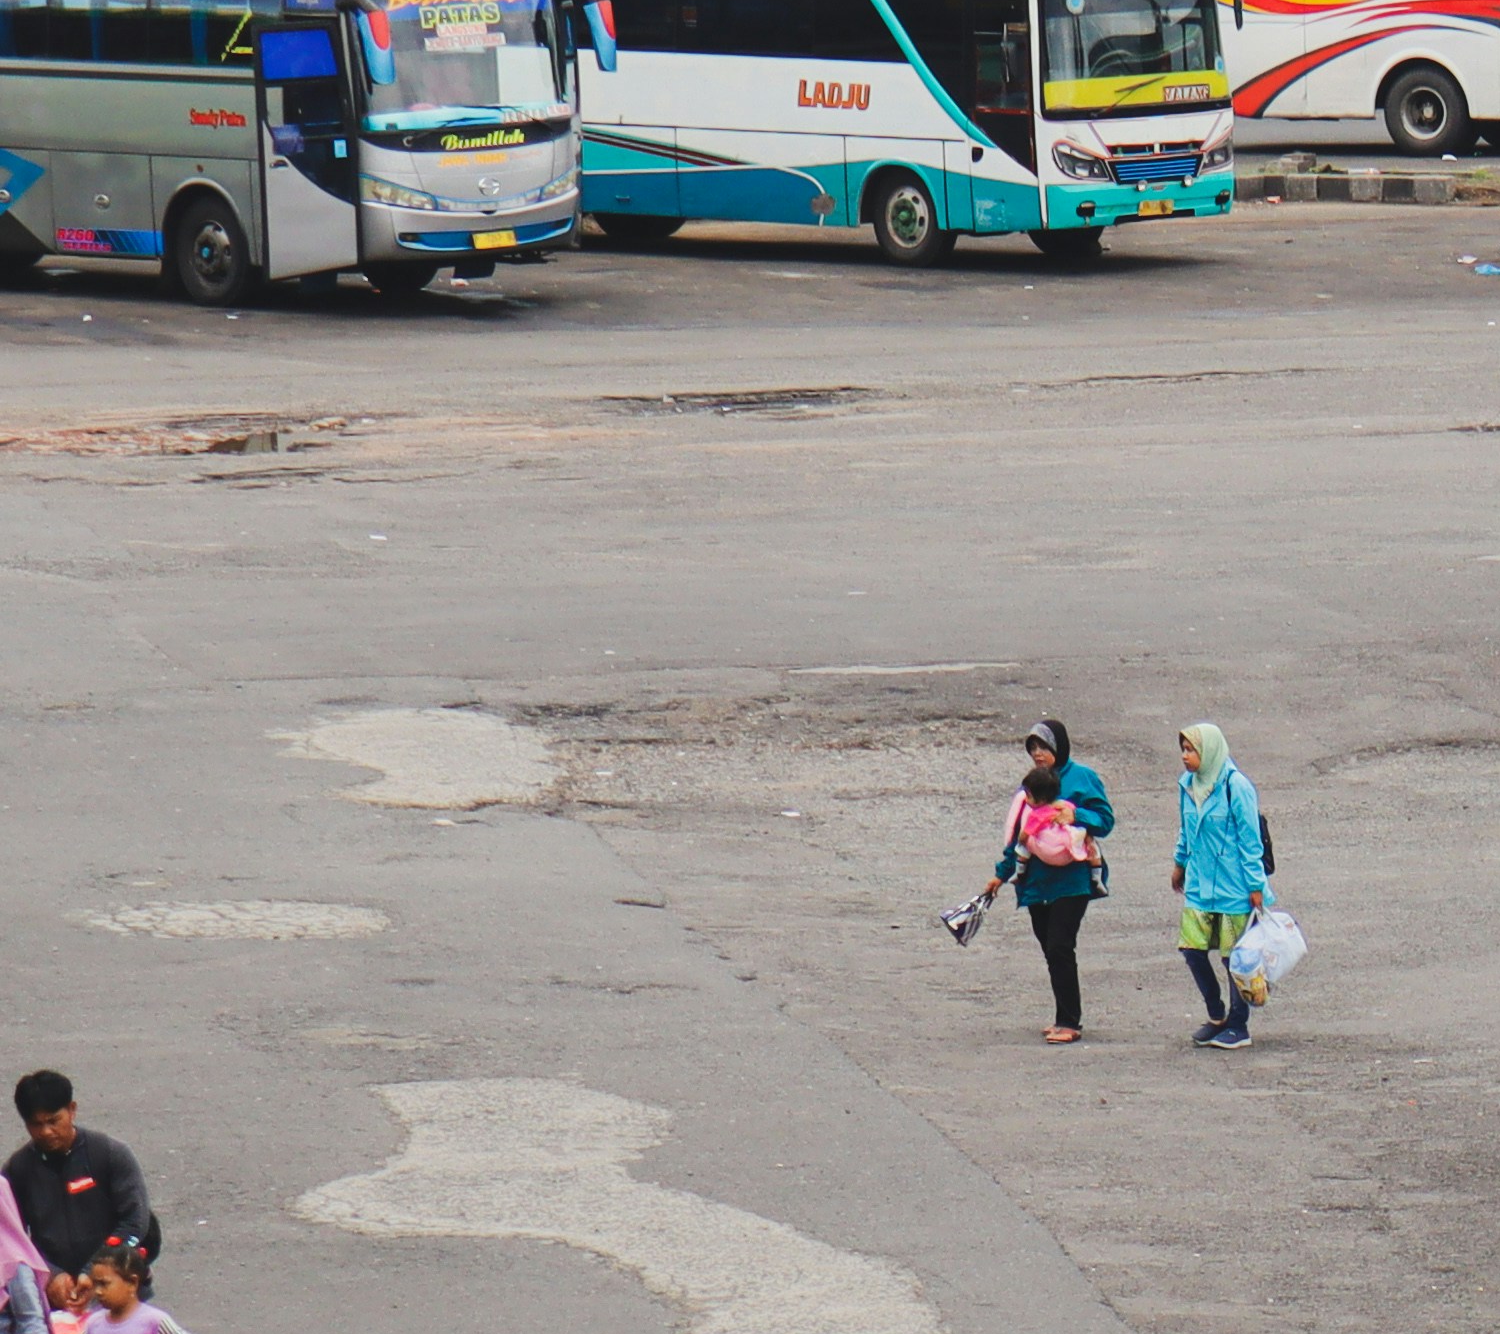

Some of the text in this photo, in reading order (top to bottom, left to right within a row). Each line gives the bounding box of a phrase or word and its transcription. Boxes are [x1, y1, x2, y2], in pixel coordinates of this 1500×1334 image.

[419, 3, 500, 28] PATAS
[798, 78, 871, 111] LADJU
[440, 128, 525, 151] Bismillah
